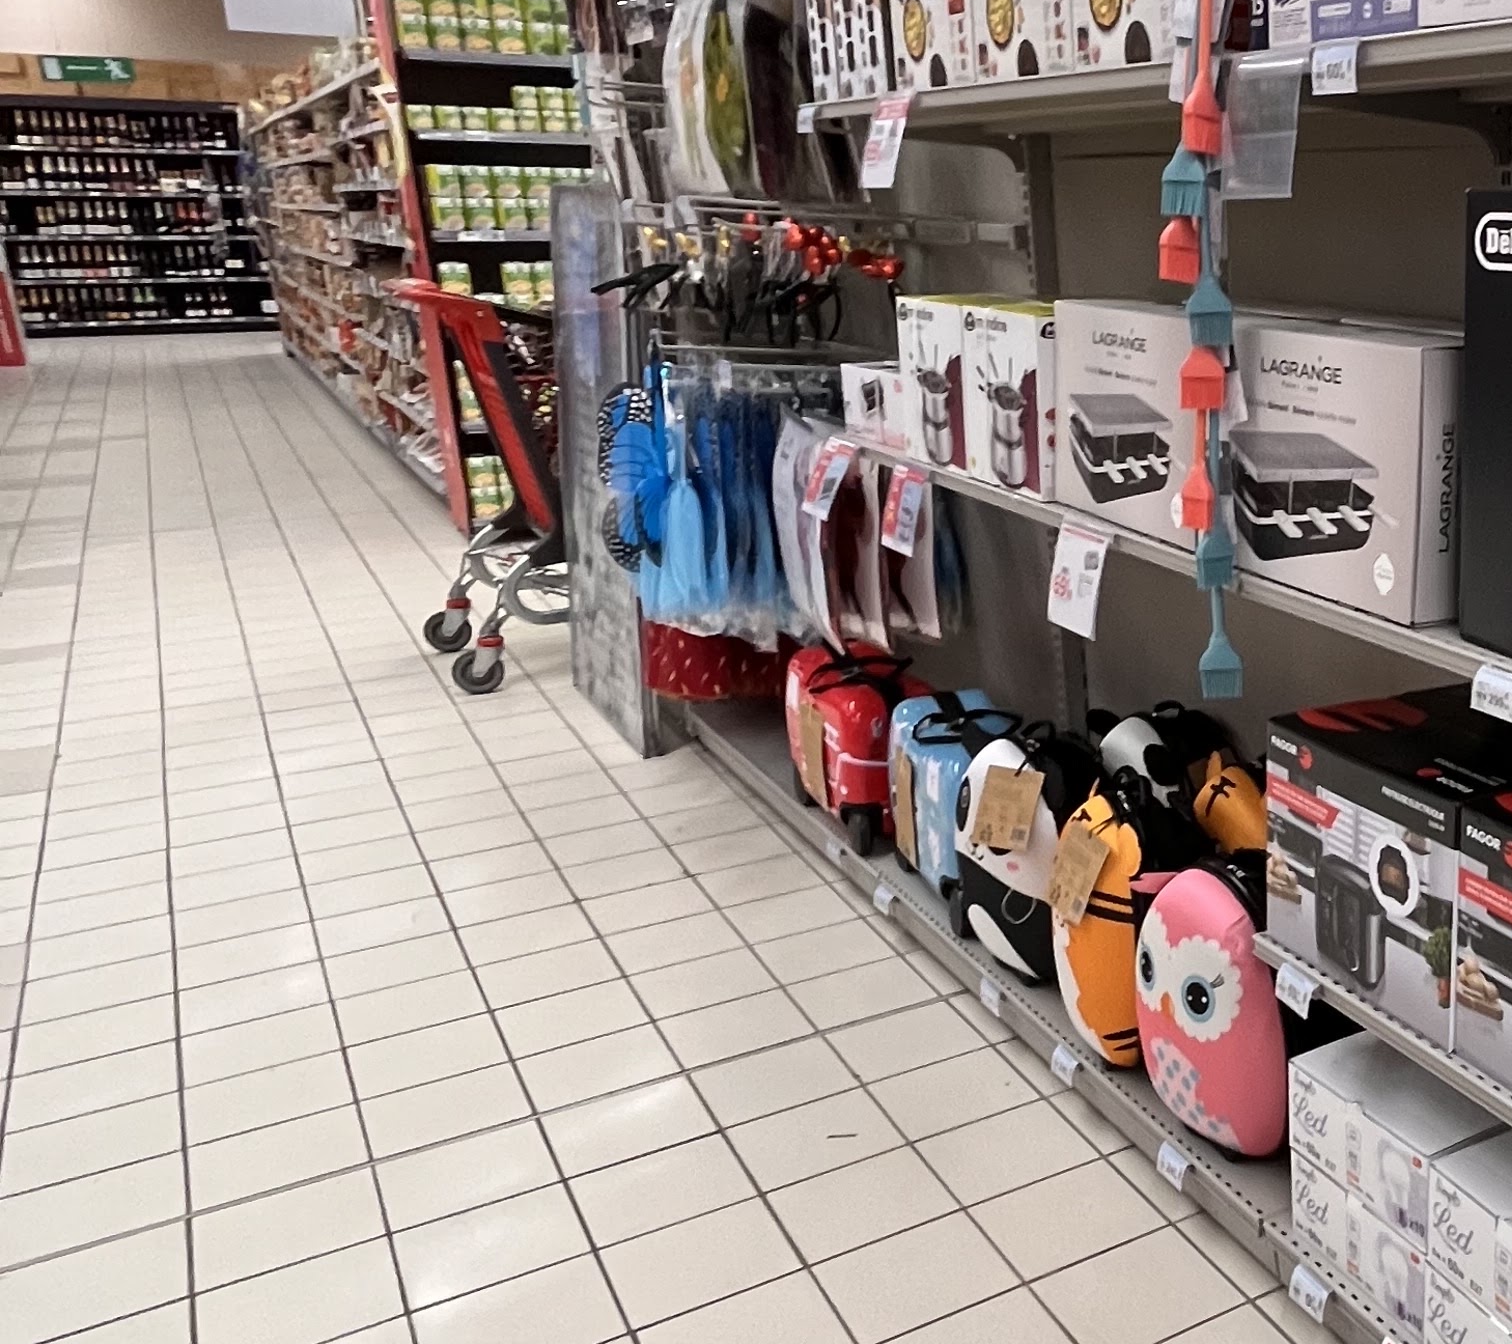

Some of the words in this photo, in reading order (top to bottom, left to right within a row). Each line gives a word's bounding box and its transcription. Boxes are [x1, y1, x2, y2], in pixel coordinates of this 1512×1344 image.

[1092, 330, 1147, 353] LAGRANGE
[1260, 356, 1342, 385] LAGRANGE
[1438, 423, 1456, 554] LAGRANGE
[1466, 825, 1501, 851] FAGOR
[1433, 1202, 1474, 1256] Led
